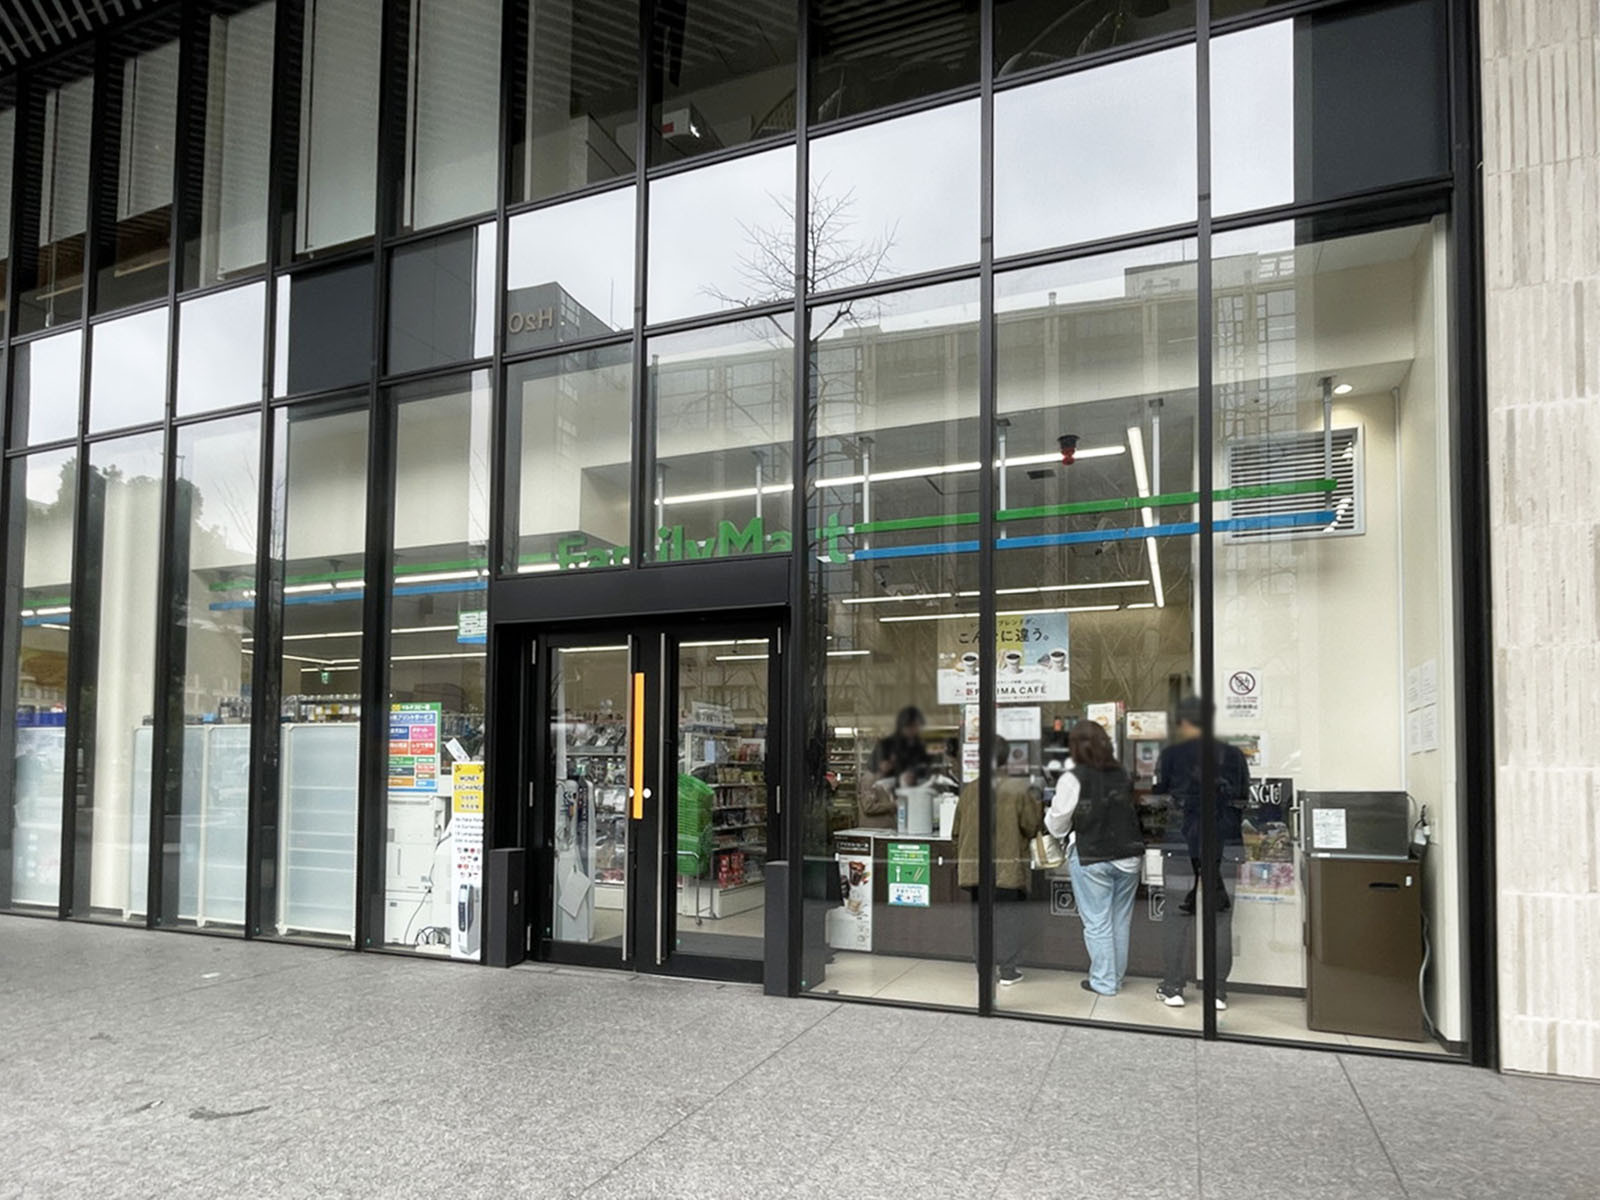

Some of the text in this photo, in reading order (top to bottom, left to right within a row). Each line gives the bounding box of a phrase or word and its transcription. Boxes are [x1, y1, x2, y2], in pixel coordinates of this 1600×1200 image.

[958, 627, 1050, 645] こんに違う。
